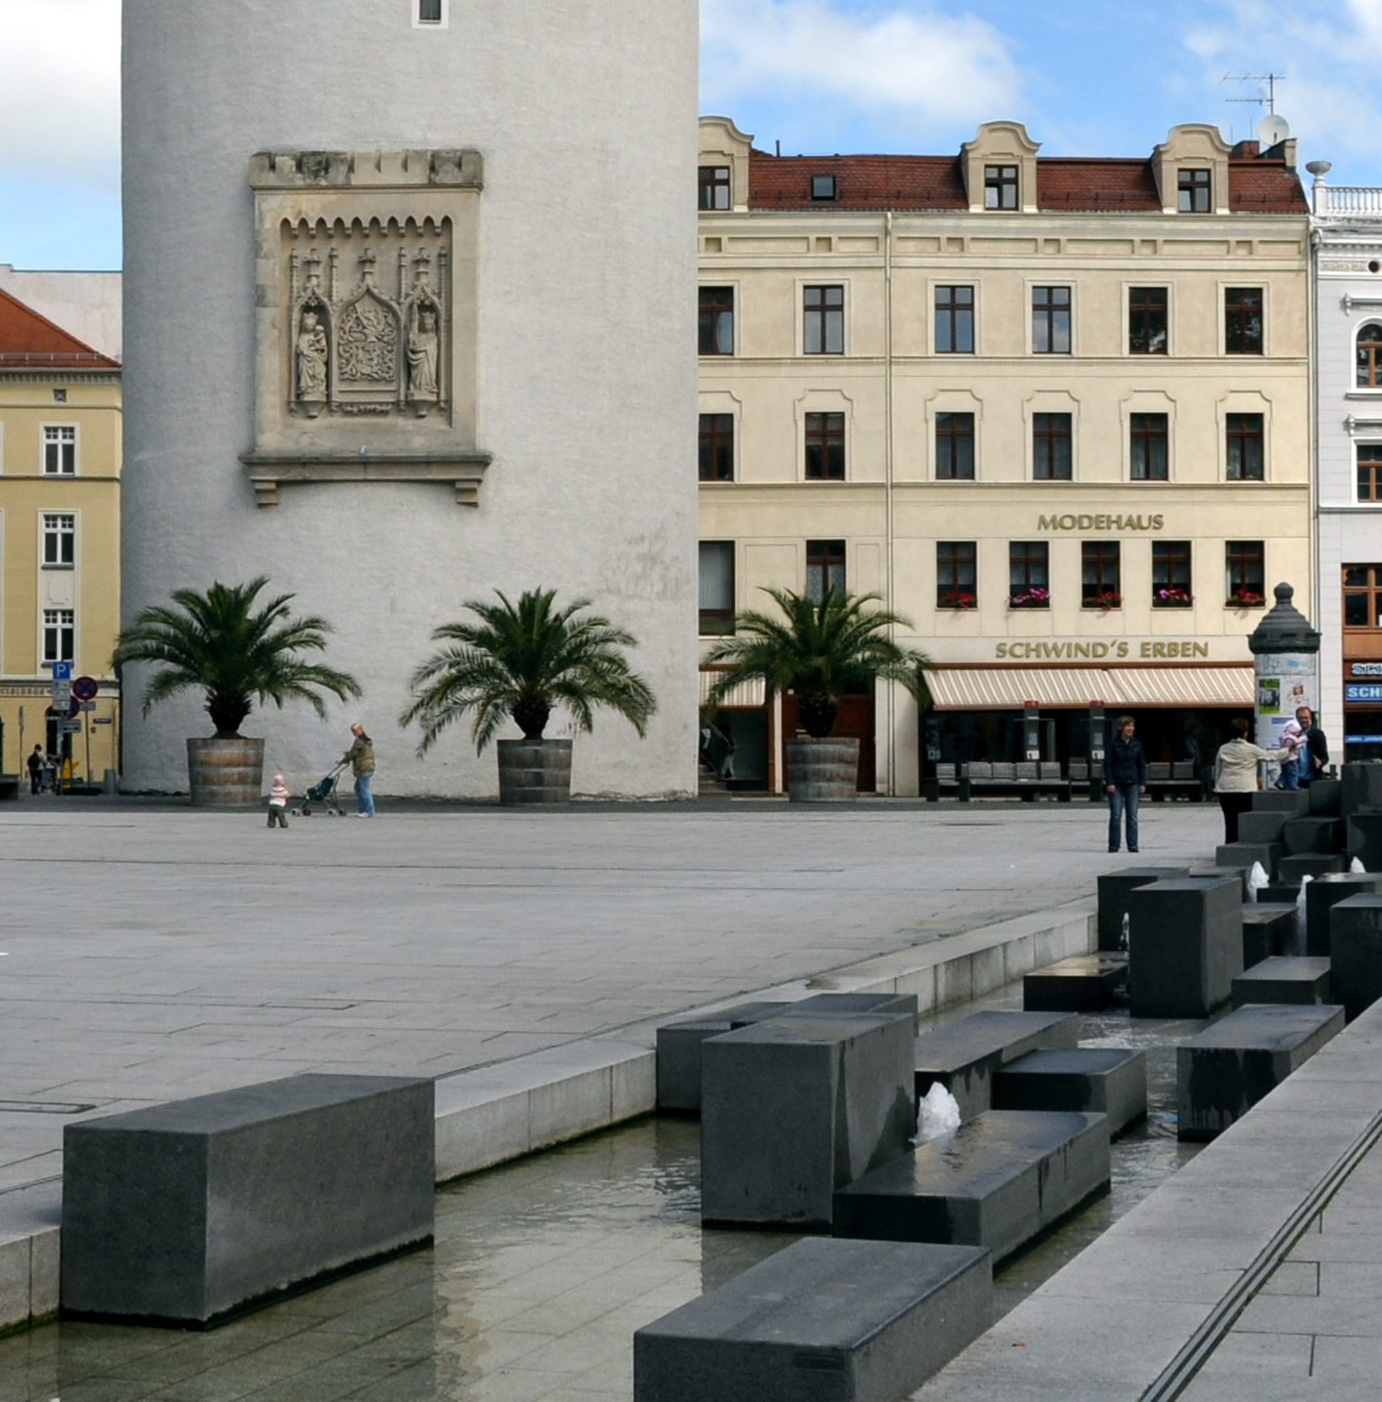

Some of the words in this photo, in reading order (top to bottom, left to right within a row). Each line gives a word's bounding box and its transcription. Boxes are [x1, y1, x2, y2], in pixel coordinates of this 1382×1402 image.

[1038, 514, 1164, 530] MODEHAUS
[1140, 641, 1209, 657] ERBEN
[57, 664, 67, 677] P
